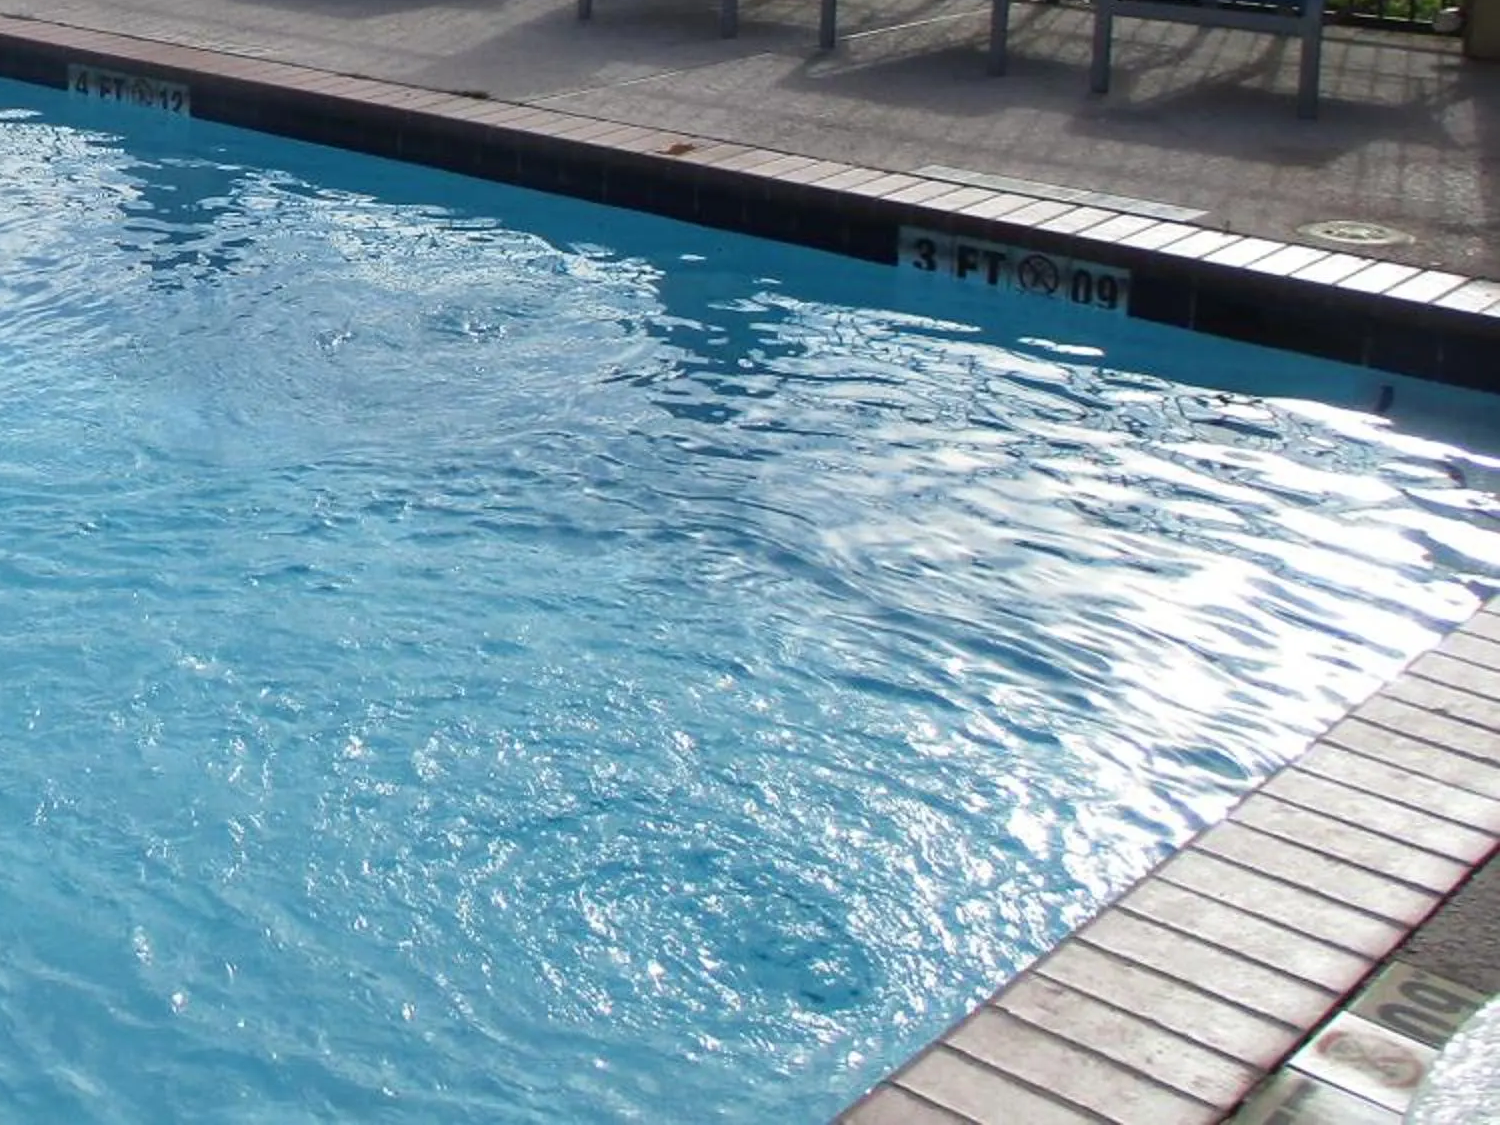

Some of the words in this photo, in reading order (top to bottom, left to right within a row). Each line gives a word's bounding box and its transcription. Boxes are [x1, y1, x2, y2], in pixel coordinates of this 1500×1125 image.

[77, 72, 89, 95] 4
[100, 76, 126, 101] FT
[914, 238, 937, 271] 3
[957, 246, 1006, 285] FT
[1072, 269, 1118, 309] 09
